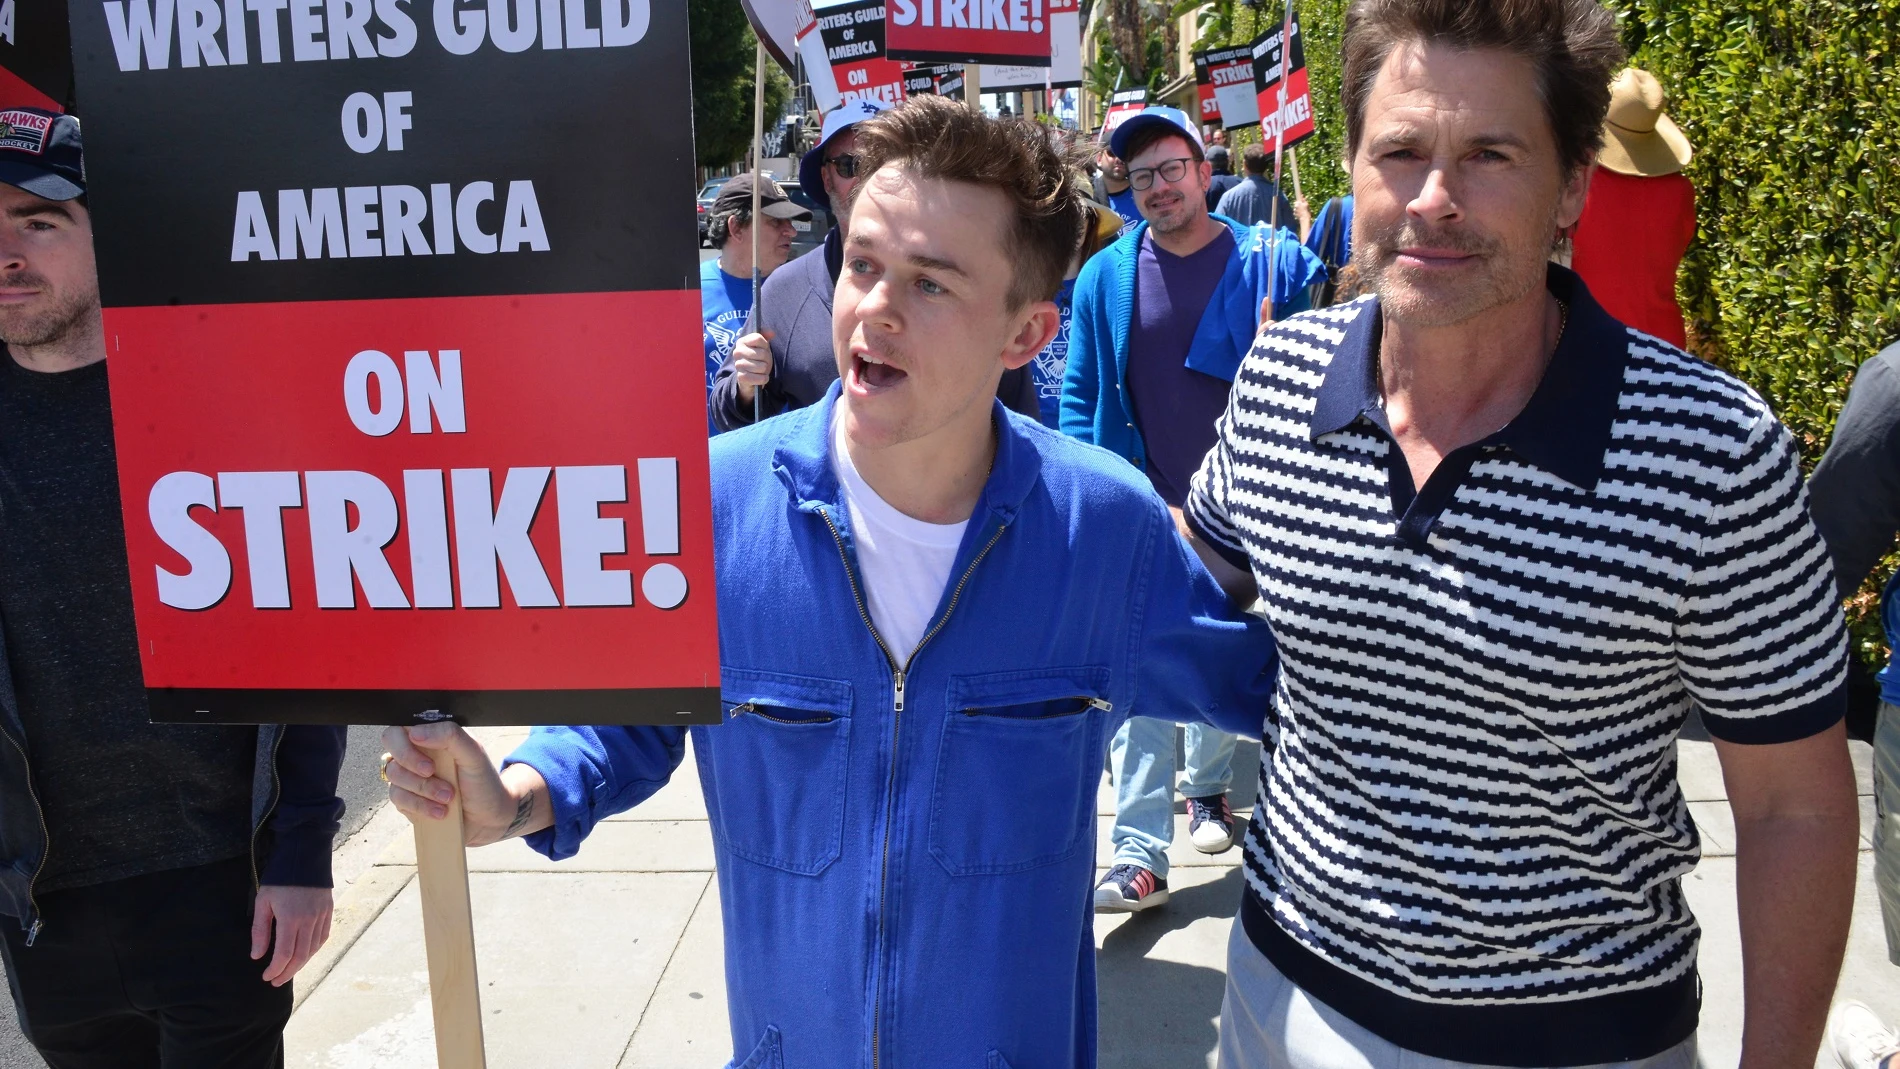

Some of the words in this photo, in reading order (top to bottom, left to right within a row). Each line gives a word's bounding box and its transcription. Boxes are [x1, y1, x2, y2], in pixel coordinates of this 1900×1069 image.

[818, 12, 853, 31] RITERS
[854, 6, 886, 24] GUILD
[893, 0, 1044, 34] STRIKE!
[103, 0, 418, 72] WRITERS
[432, 0, 651, 56] GUILD
[843, 29, 854, 40] OF
[828, 40, 877, 60] AMERICA
[1207, 50, 1236, 62] WRITERS
[847, 68, 868, 86] ON
[911, 77, 932, 90] GUILD
[340, 91, 413, 154] OF
[230, 180, 551, 261] AMERICA
[343, 349, 468, 437] ON
[147, 456, 689, 611] STRIKE!
